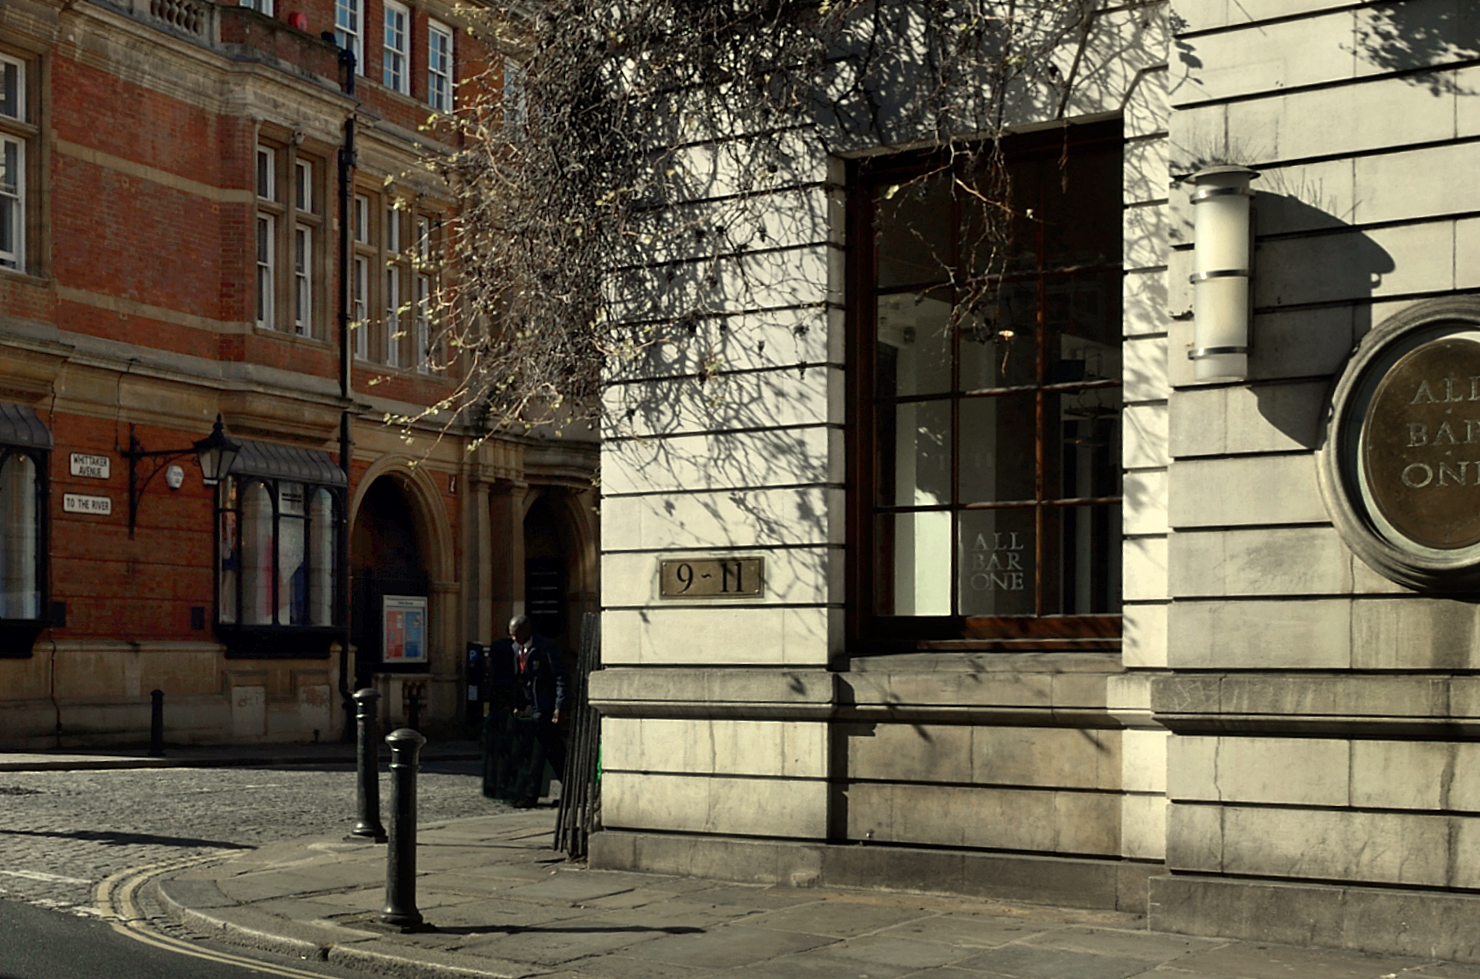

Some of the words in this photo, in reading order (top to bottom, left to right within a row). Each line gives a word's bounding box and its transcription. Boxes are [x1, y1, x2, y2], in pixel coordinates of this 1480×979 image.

[74, 455, 107, 467] WHITTAKER
[78, 466, 102, 477] AVENUE
[66, 497, 75, 508] TO
[78, 499, 90, 510] THE
[92, 500, 109, 511] RIVER
[972, 531, 1024, 551] ALL
[972, 552, 1023, 571] BAR
[970, 572, 1024, 591] ONE
